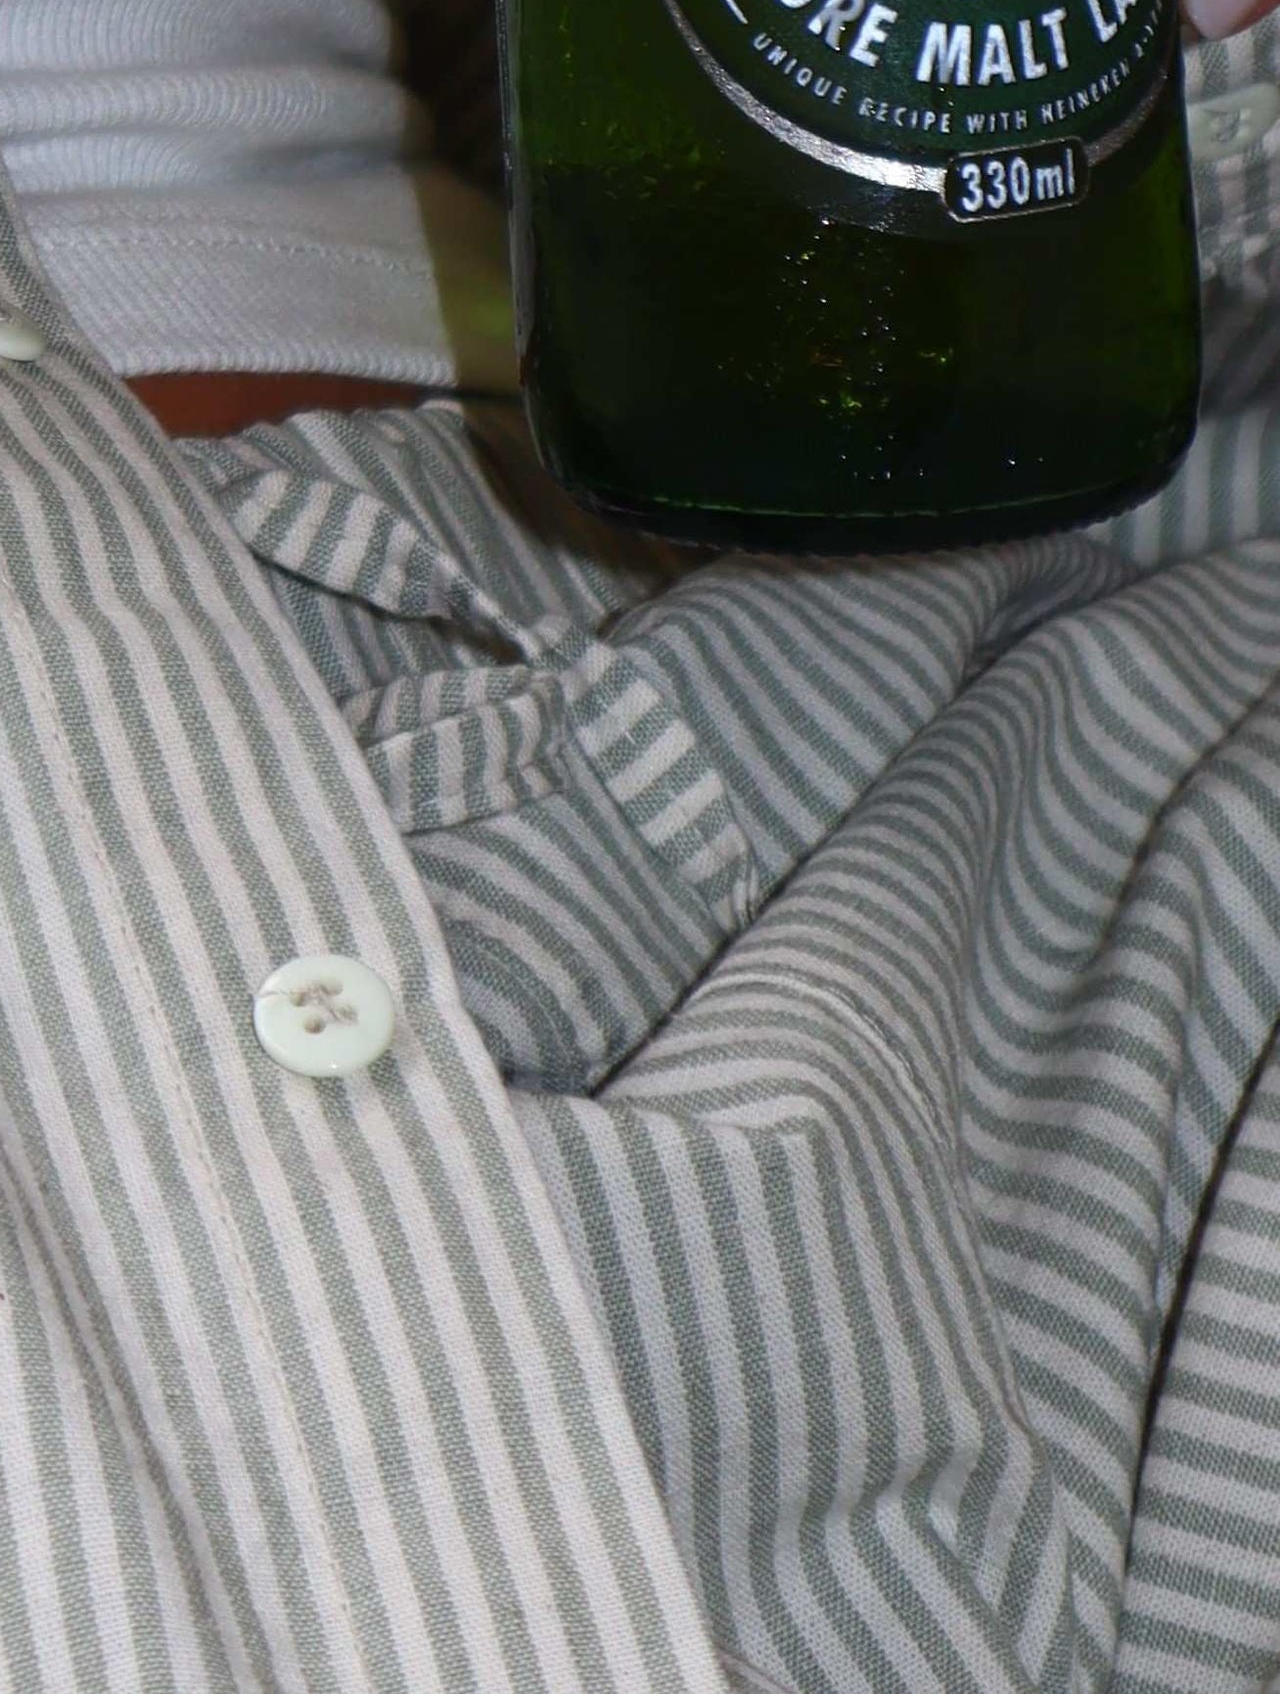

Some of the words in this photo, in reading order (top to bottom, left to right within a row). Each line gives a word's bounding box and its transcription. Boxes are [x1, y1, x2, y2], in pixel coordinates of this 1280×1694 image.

[752, 32, 848, 105] UNIQUE
[859, 97, 952, 135] RECIPE
[966, 109, 1029, 136] WITH
[915, 8, 1070, 87] MALT
[959, 147, 1077, 212] 330ml
